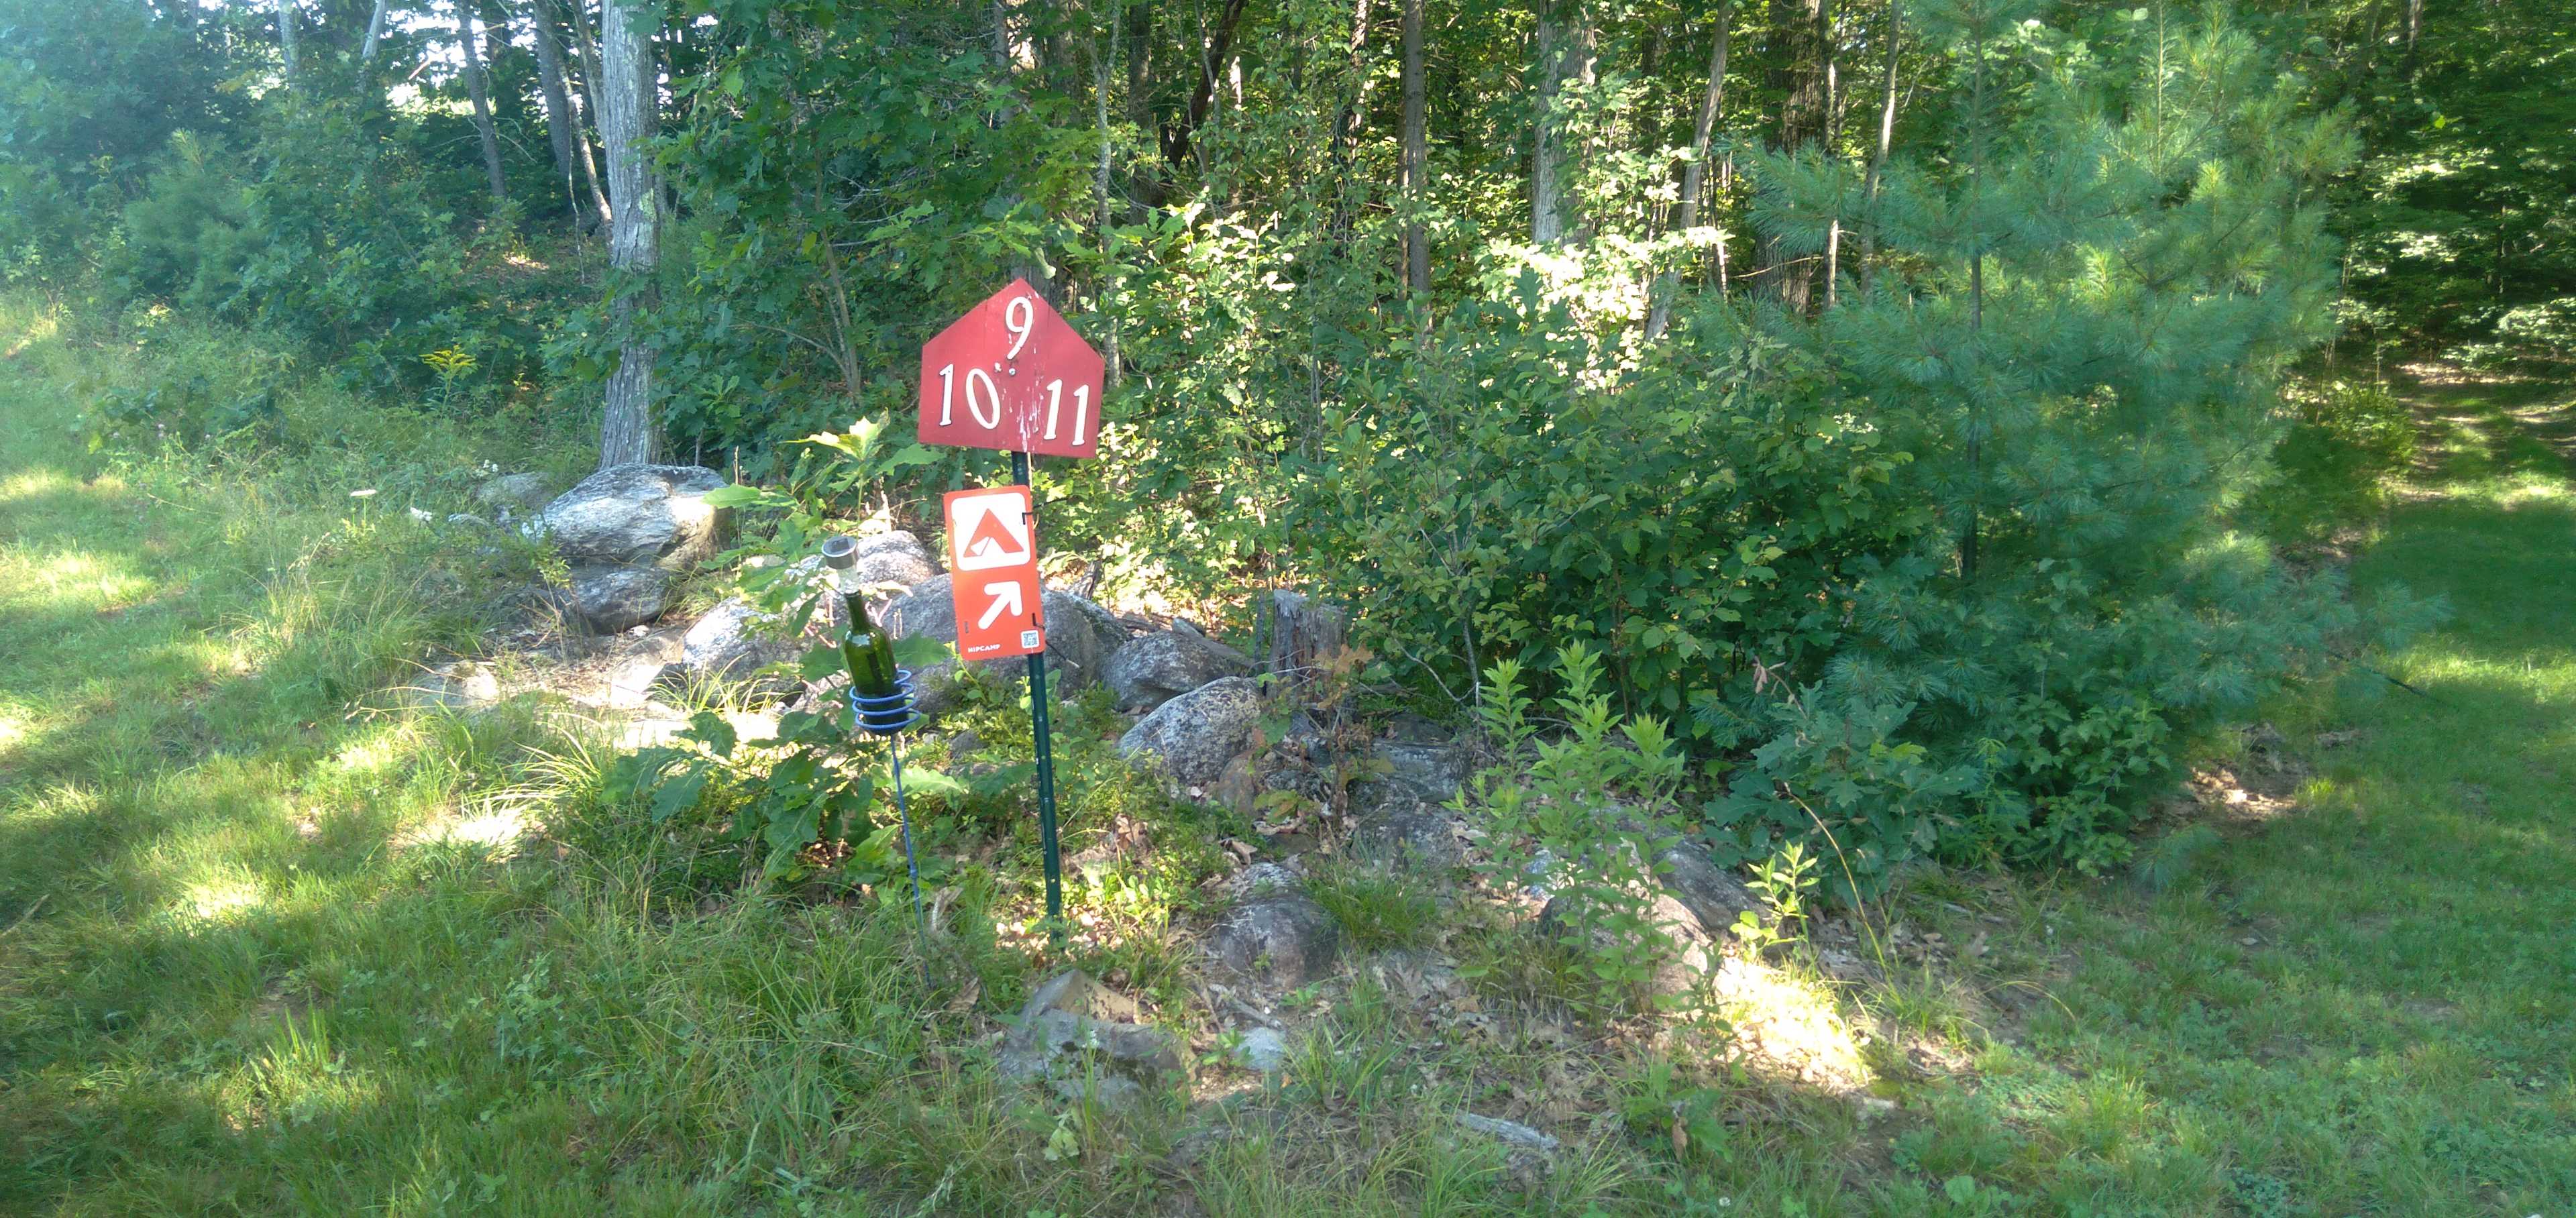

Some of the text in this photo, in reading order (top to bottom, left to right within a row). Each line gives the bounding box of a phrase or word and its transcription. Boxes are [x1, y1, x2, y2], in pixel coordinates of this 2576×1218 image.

[1006, 296, 1034, 360] 9
[938, 364, 1001, 430] 10
[1043, 379, 1089, 446] 11
[967, 644, 1001, 653] HIPCAMP
